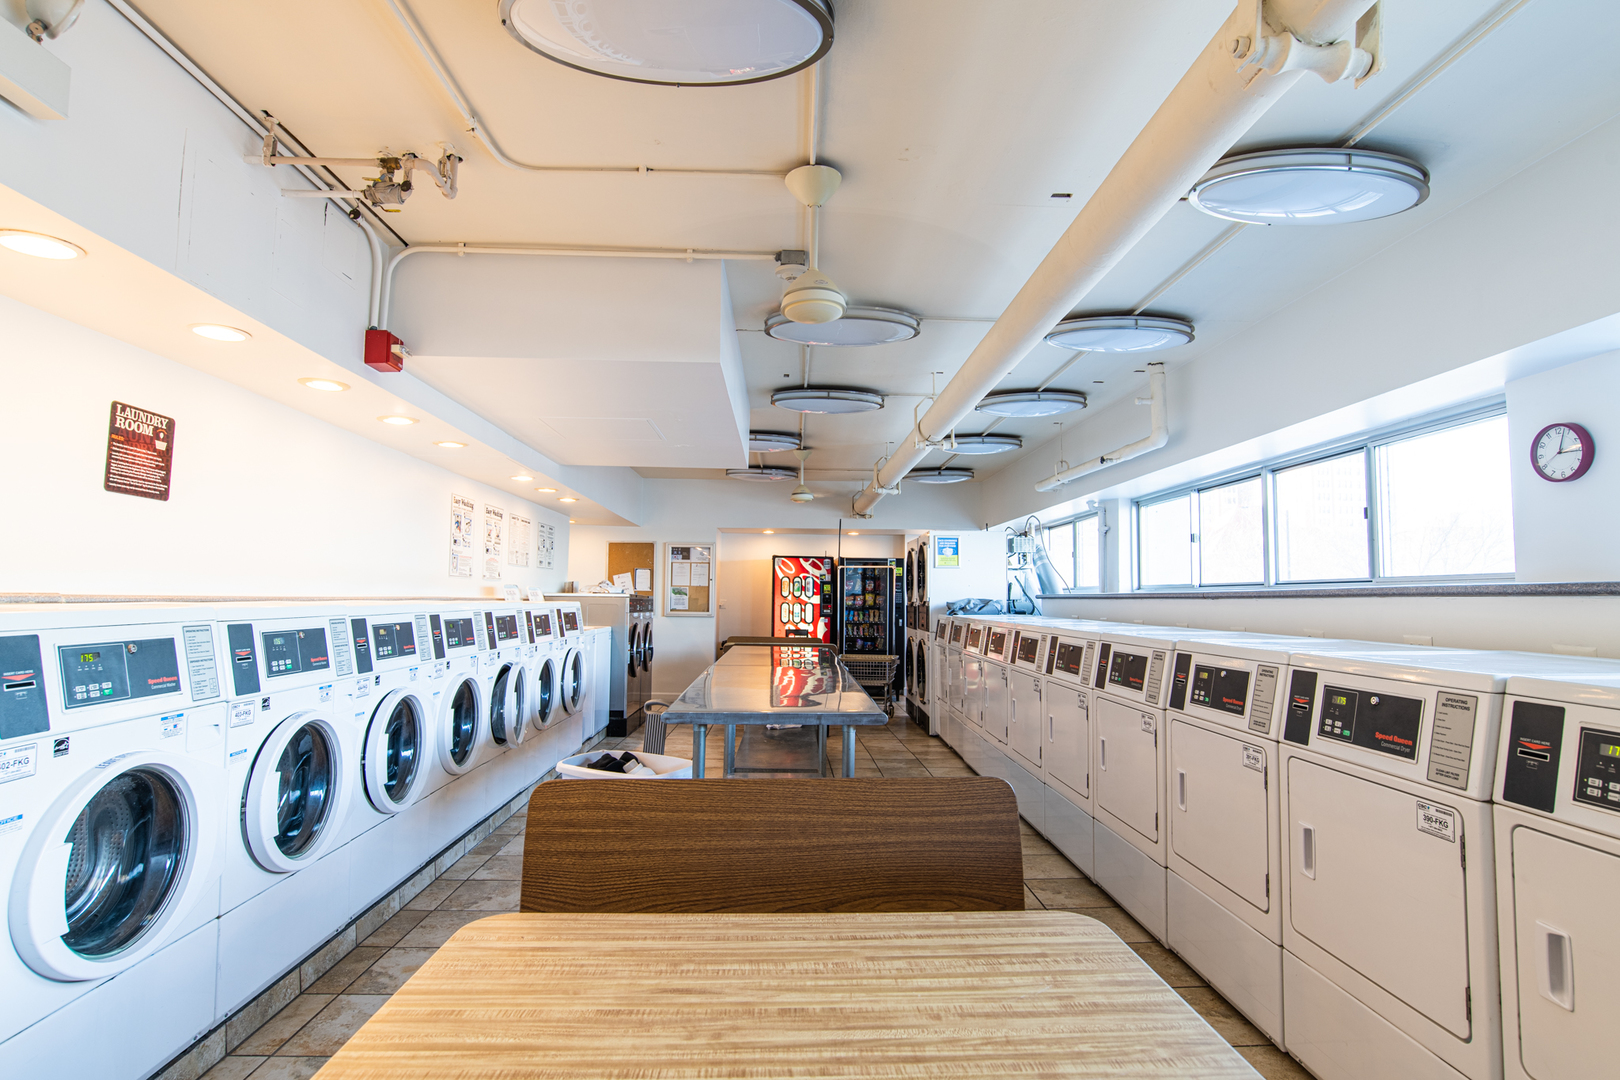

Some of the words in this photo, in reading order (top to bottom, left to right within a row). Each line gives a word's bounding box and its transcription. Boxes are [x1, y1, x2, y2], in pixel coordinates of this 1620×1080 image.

[116, 403, 169, 430] LAUNDRY
[115, 415, 154, 437] ROOM
[81, 654, 93, 663] 175
[148, 677, 163, 685] Speed
[1441, 702, 1471, 711] INSTRUCTIONS
[1445, 697, 1468, 706] OPERATING
[1375, 731, 1394, 741] Speed
[1393, 735, 1413, 746] Queen
[1381, 740, 1401, 751] Commercial
[1400, 745, 1411, 753] Dryer
[1422, 813, 1449, 829] 390-FKG
